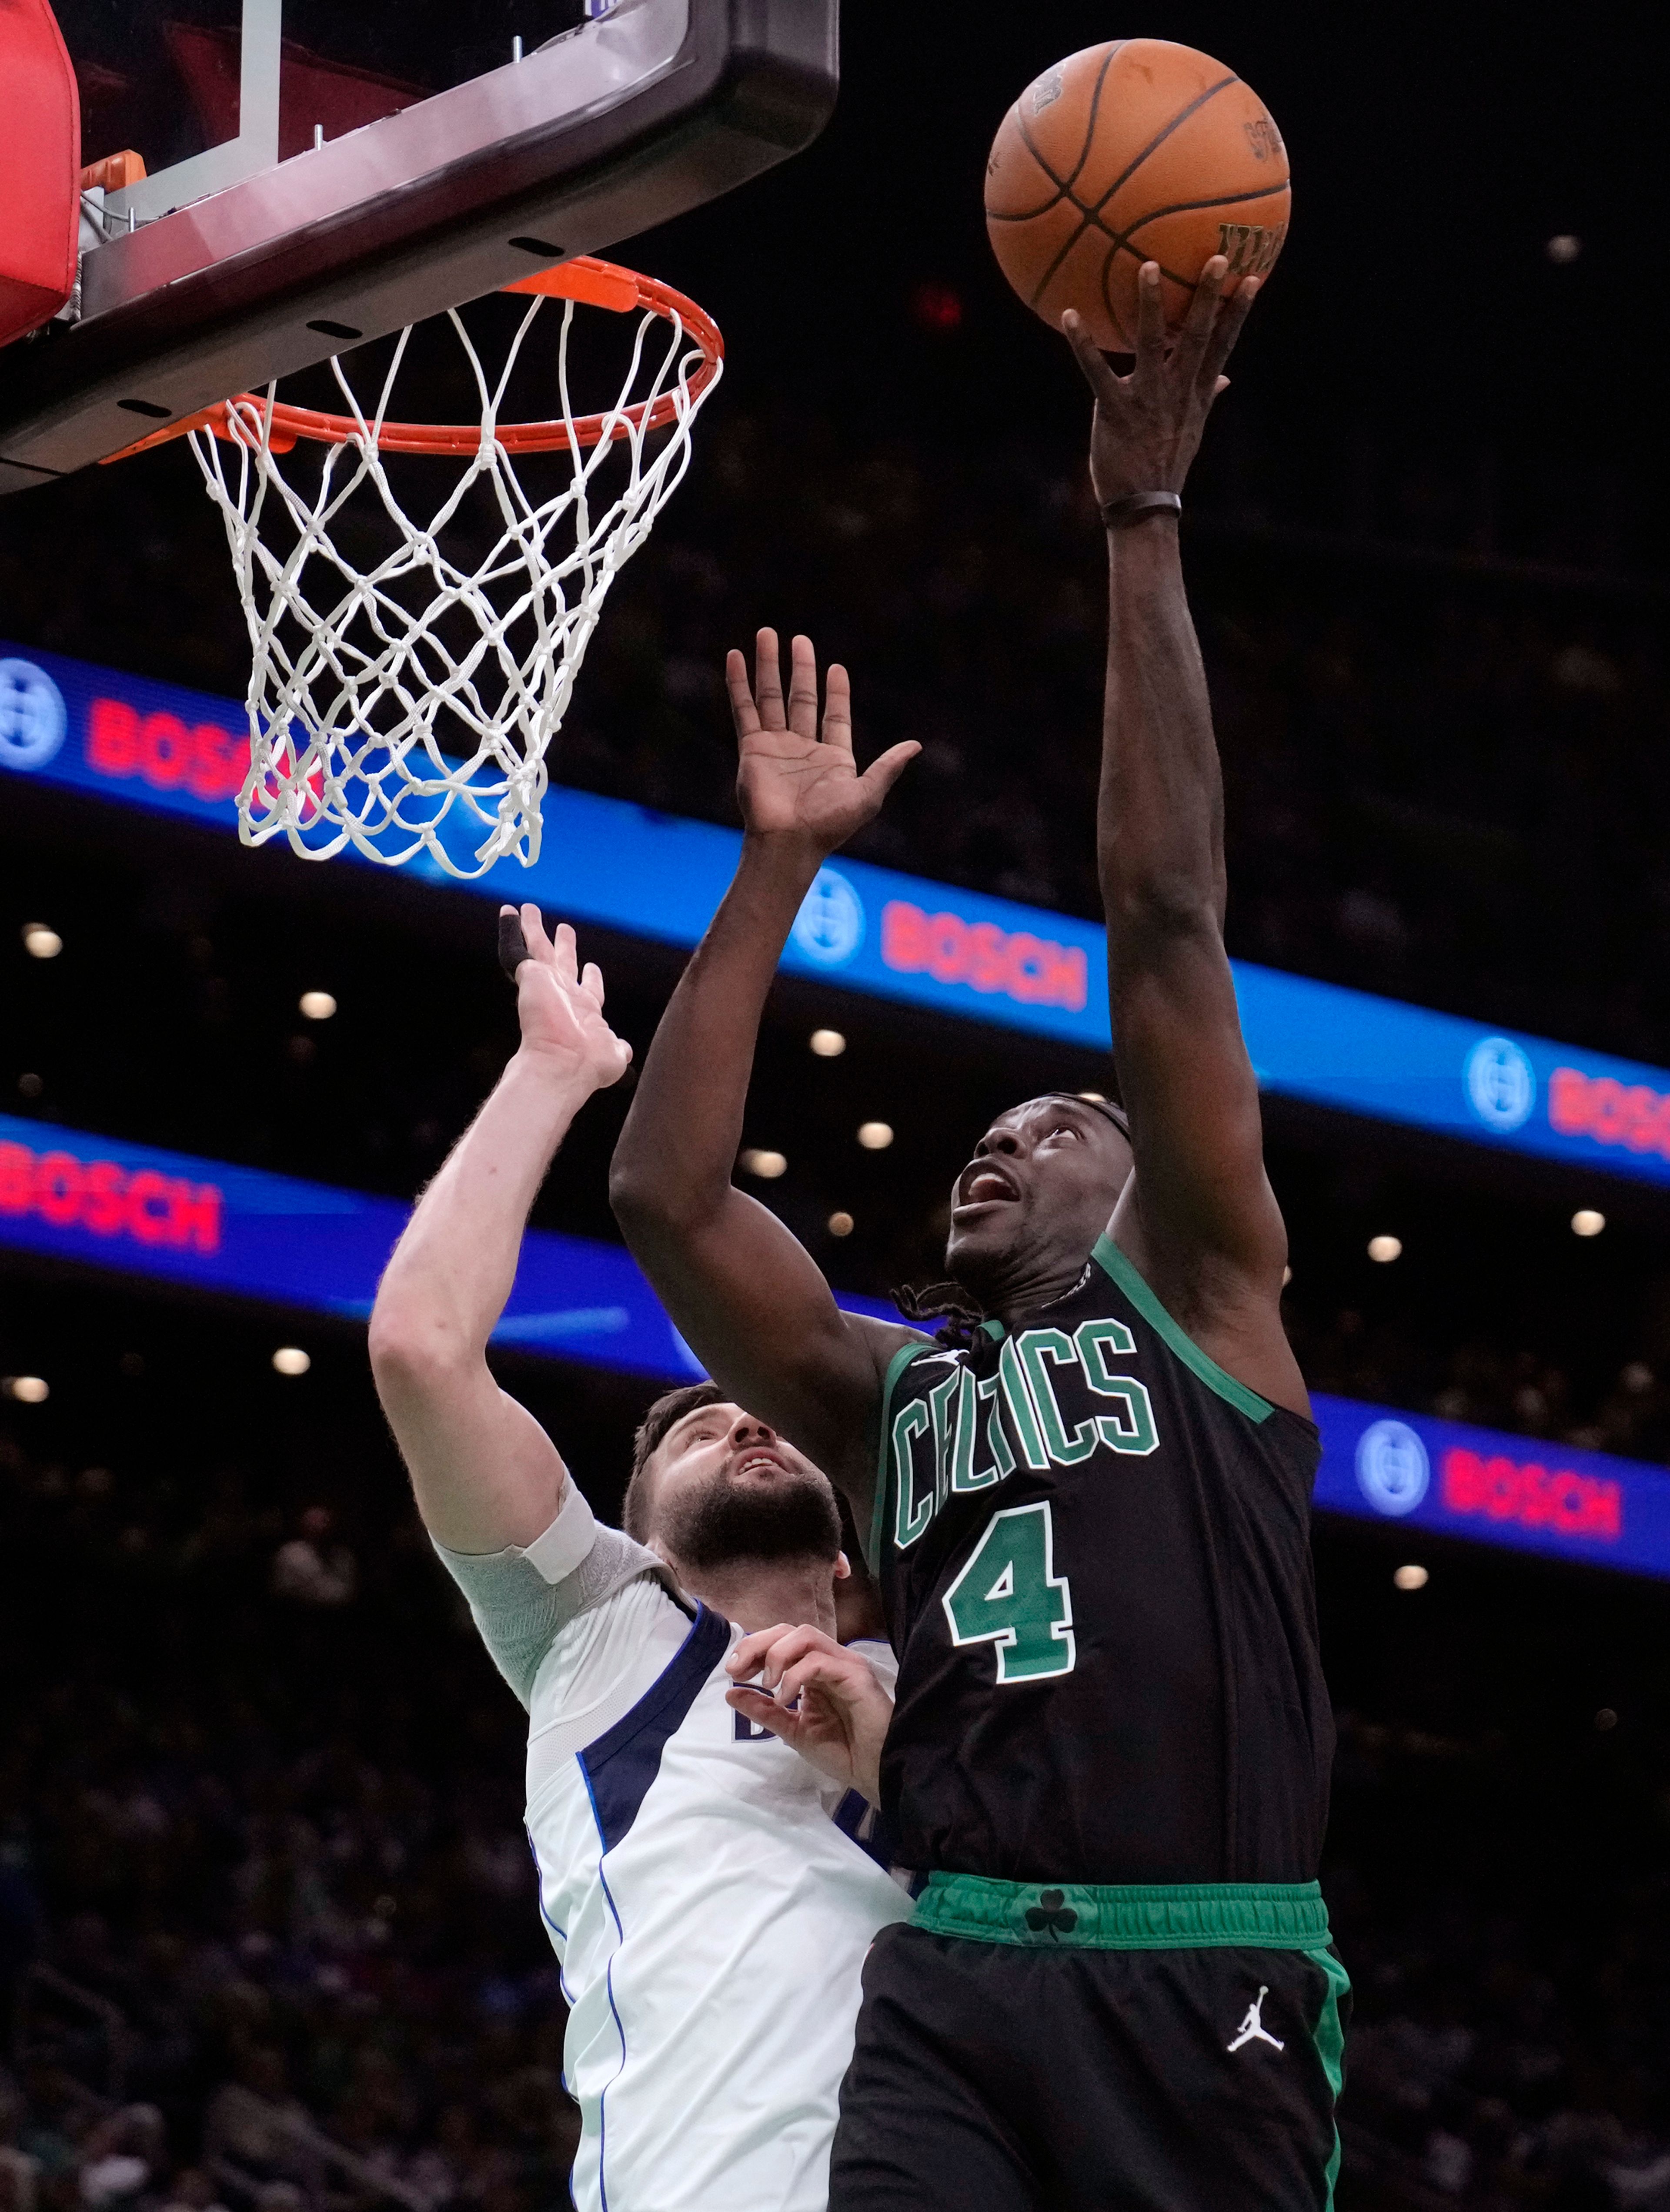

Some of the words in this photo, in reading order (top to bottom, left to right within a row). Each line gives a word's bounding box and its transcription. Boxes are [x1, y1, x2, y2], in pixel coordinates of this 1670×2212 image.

[881, 900, 1088, 1013] BOSCH
[892, 1318, 1160, 1549] CELTICS
[1443, 1446, 1623, 1544] BOSCH
[942, 1500, 1076, 1684] 4
